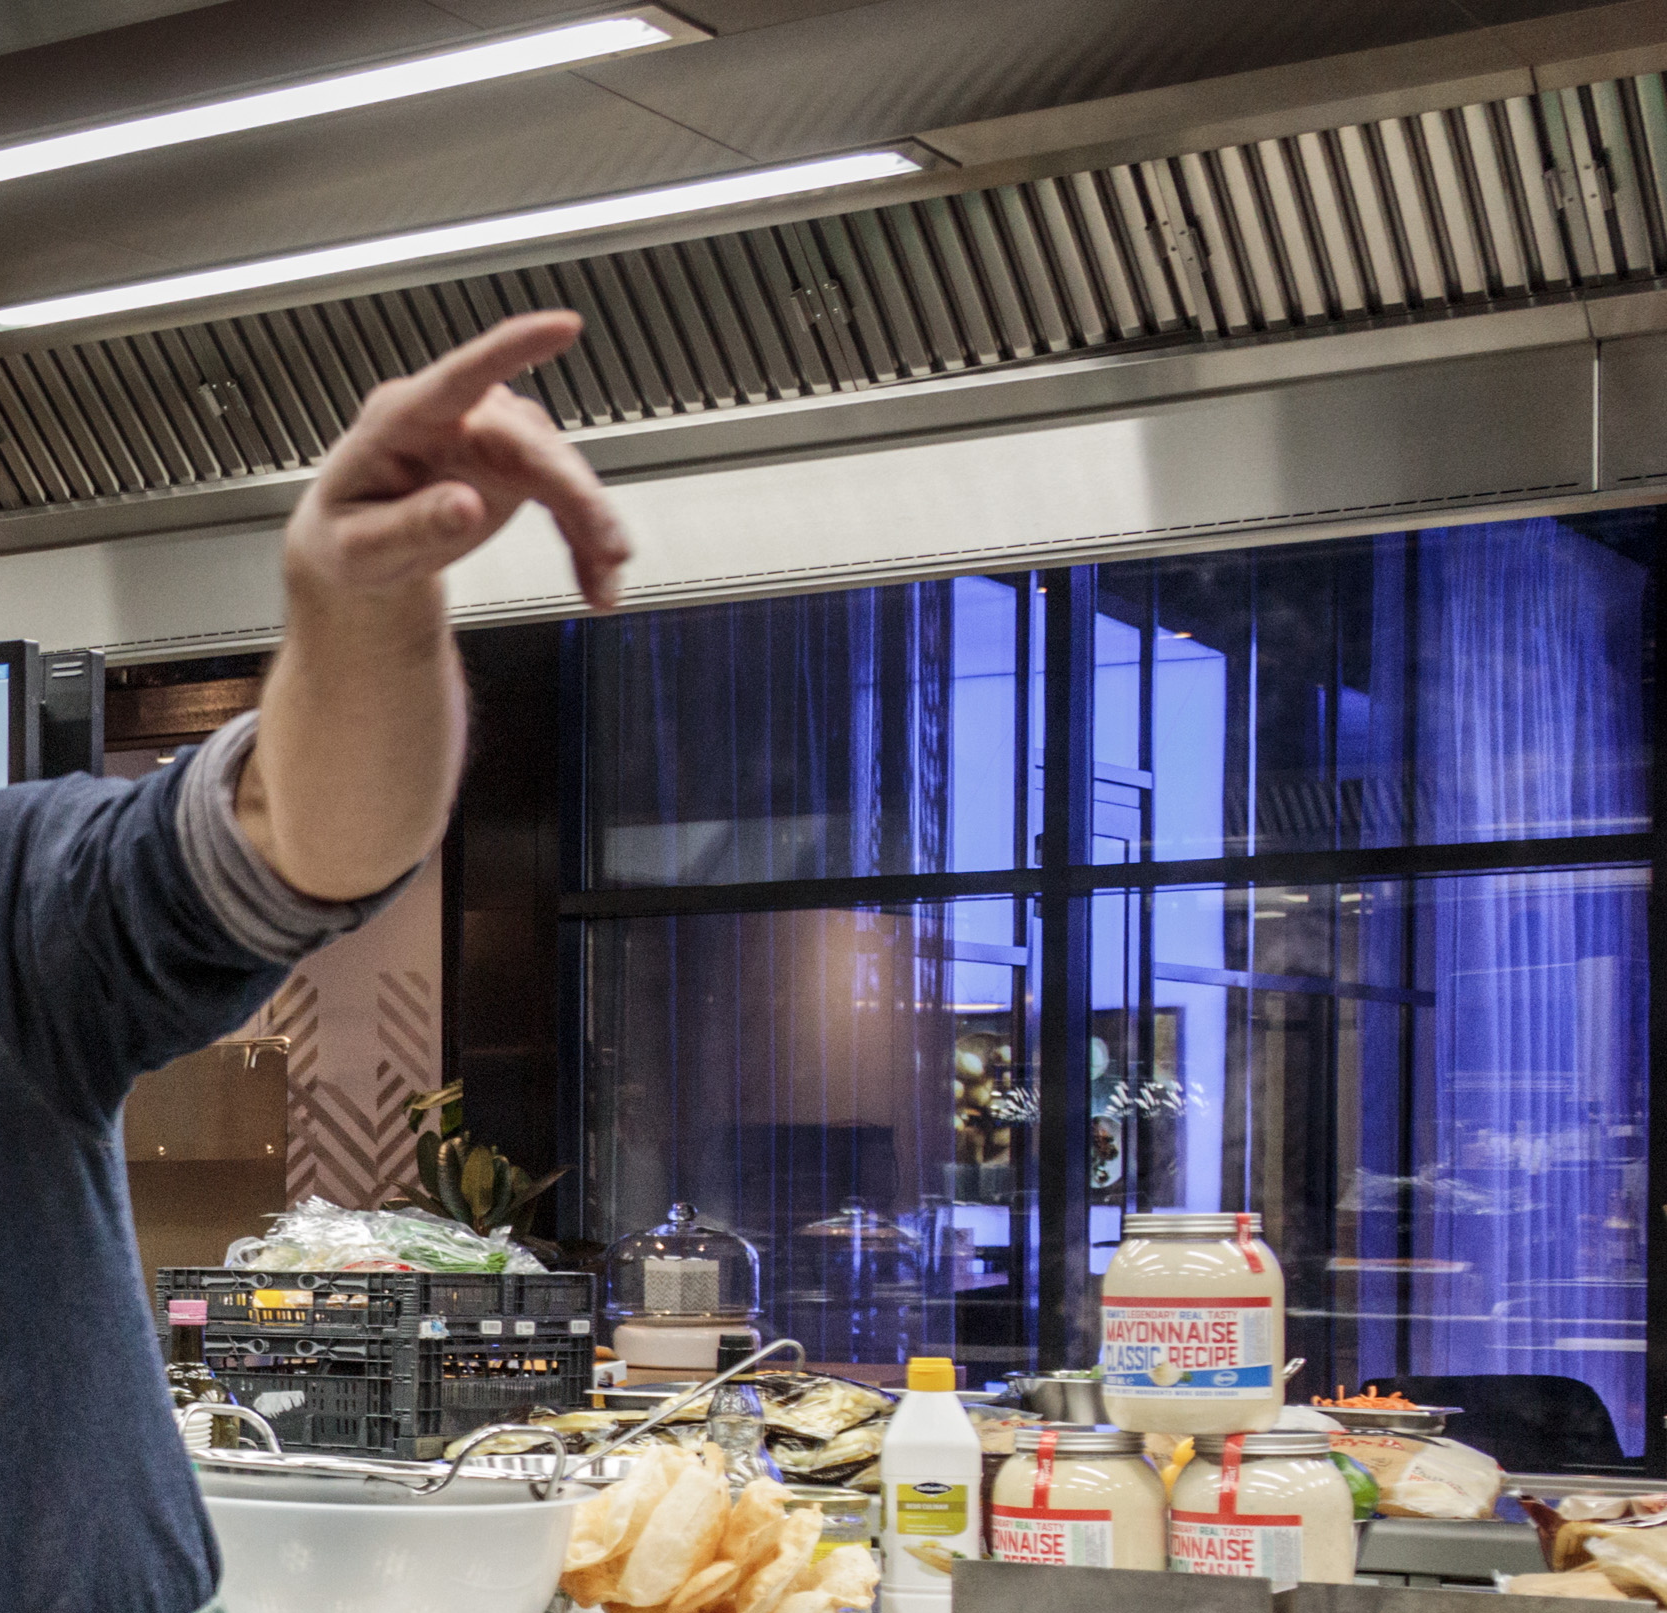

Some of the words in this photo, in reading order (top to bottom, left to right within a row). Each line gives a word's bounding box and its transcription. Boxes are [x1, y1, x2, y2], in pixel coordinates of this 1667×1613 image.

[1127, 1310, 1176, 1320] LEGENDARY
[1179, 1310, 1204, 1320] REAL
[1208, 1310, 1239, 1320] TASTY
[1106, 1320, 1238, 1344] MAYONNAISE
[1106, 1345, 1162, 1372] CLASSIC
[1168, 1346, 1239, 1369] RECIPE
[1015, 1520, 1033, 1531] REAL
[1036, 1522, 1065, 1532] TASTY
[1199, 1526, 1220, 1536] REAL
[1223, 1527, 1255, 1538] TASTY
